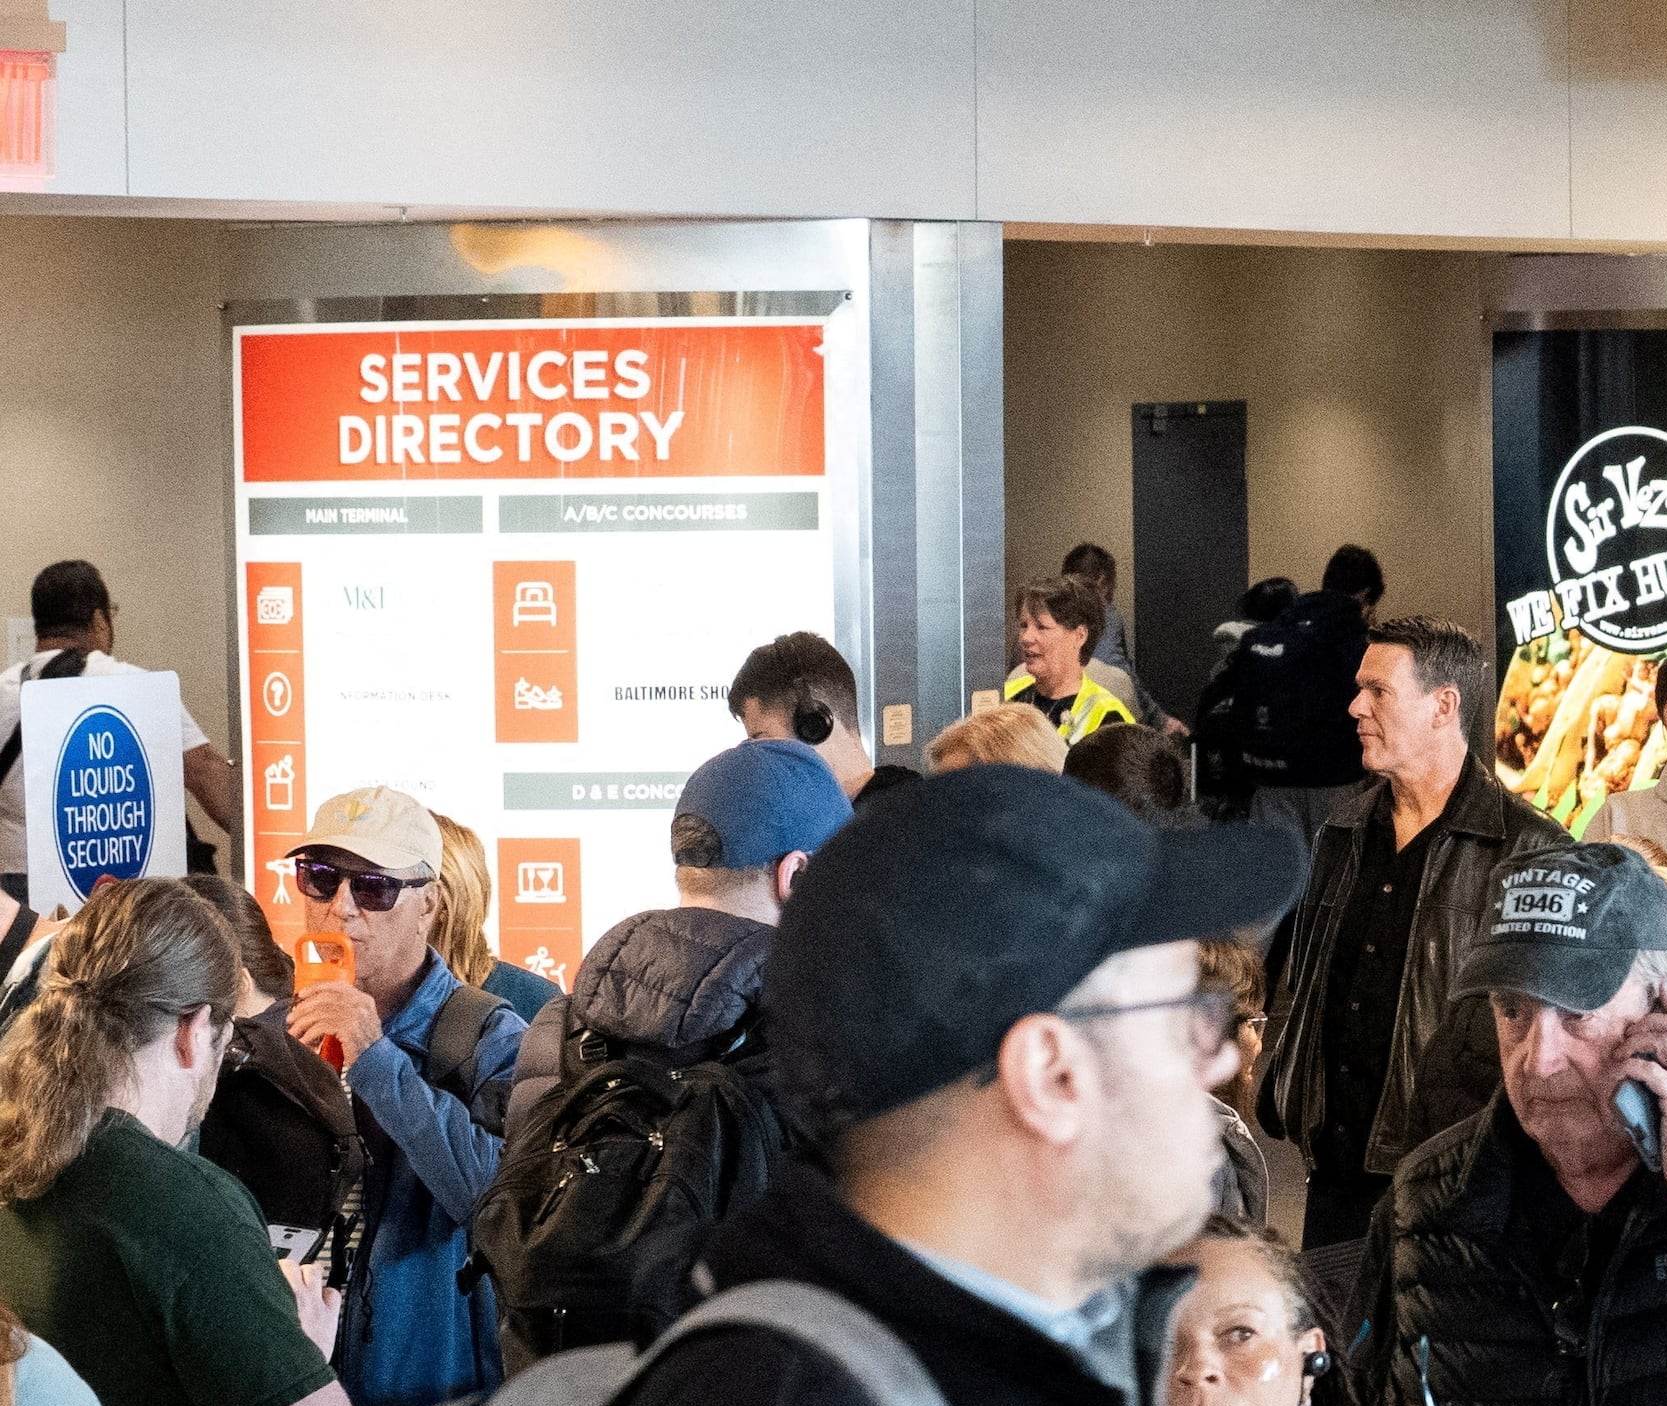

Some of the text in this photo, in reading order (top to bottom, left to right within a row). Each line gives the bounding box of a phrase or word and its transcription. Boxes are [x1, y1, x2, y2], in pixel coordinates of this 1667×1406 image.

[359, 348, 651, 403] SERVICES
[338, 409, 686, 465] DIRECTORY
[305, 508, 408, 523] MAIN TERMINAL
[563, 503, 748, 522] A/B/C CONCOURSES
[1563, 480, 1617, 574] Sir
[1506, 589, 1556, 645] WE
[1555, 564, 1630, 631] FIX
[614, 684, 730, 701] BALTIMORE SHO
[88, 731, 115, 761] NO
[70, 764, 136, 798] LIQUIDS
[571, 783, 586, 800] D
[590, 783, 602, 800] &
[607, 783, 619, 800] E
[63, 800, 146, 835] THROUGH
[67, 834, 144, 869] SECURITY
[1501, 868, 1596, 894] VINTAGE
[1513, 893, 1564, 913] 1946
[1490, 922, 1587, 940] LIMITED EDITION
